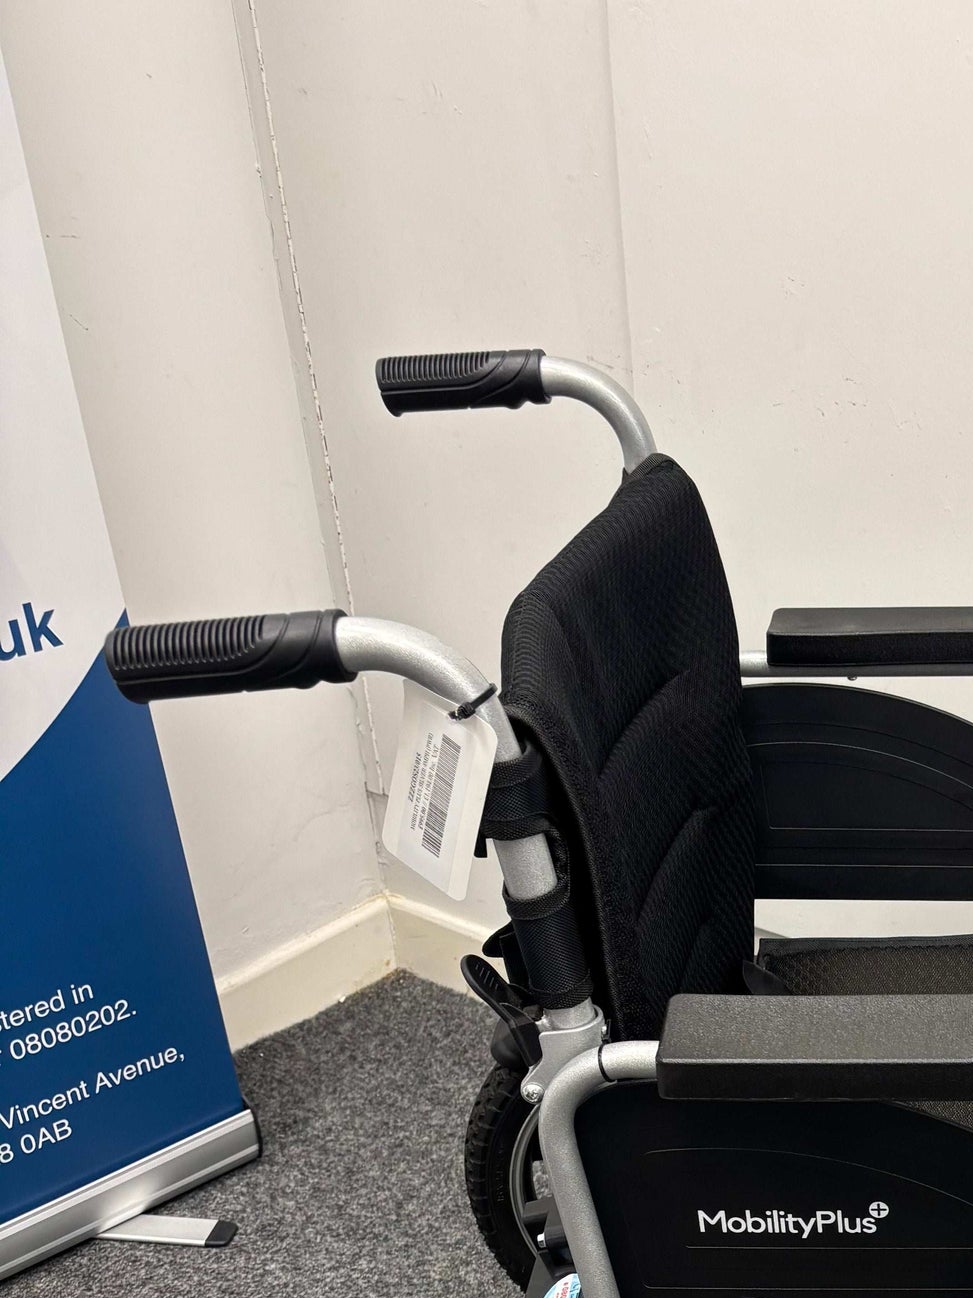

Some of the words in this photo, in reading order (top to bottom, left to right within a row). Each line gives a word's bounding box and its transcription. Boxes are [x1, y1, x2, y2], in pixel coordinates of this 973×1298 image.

[0, 602, 64, 661] uk
[410, 801, 419, 832] MOBILITY
[419, 768, 427, 789] SILVER
[70, 984, 94, 1005] in
[9, 999, 137, 1060] 08080202.
[0, 1080, 90, 1129] Vincent
[95, 1046, 185, 1094] Avenue,
[20, 1118, 73, 1154] 0AB
[697, 1209, 877, 1239] MobilityPlus
